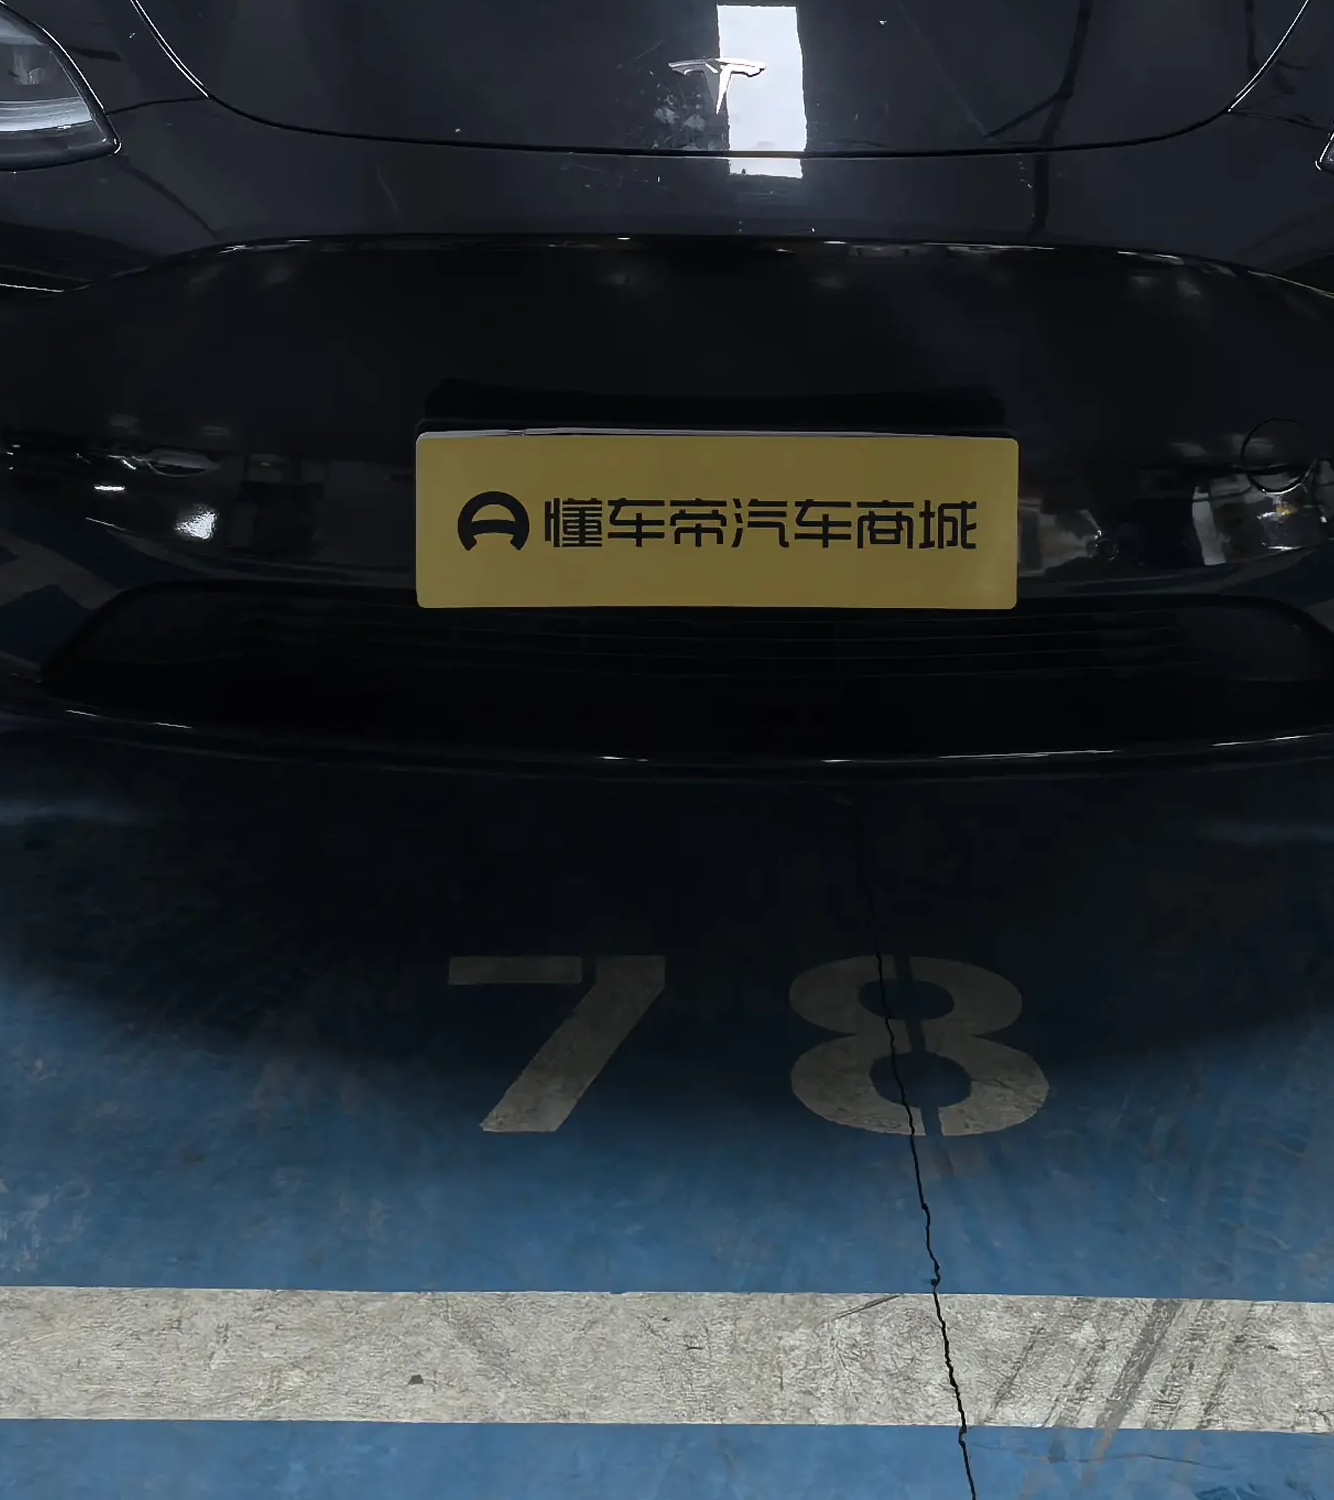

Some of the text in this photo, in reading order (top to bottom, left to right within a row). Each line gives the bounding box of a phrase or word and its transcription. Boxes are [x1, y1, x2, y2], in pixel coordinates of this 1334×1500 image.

[544, 497, 978, 550] 懂车帝汽车商城
[447, 954, 1051, 1137] 78
